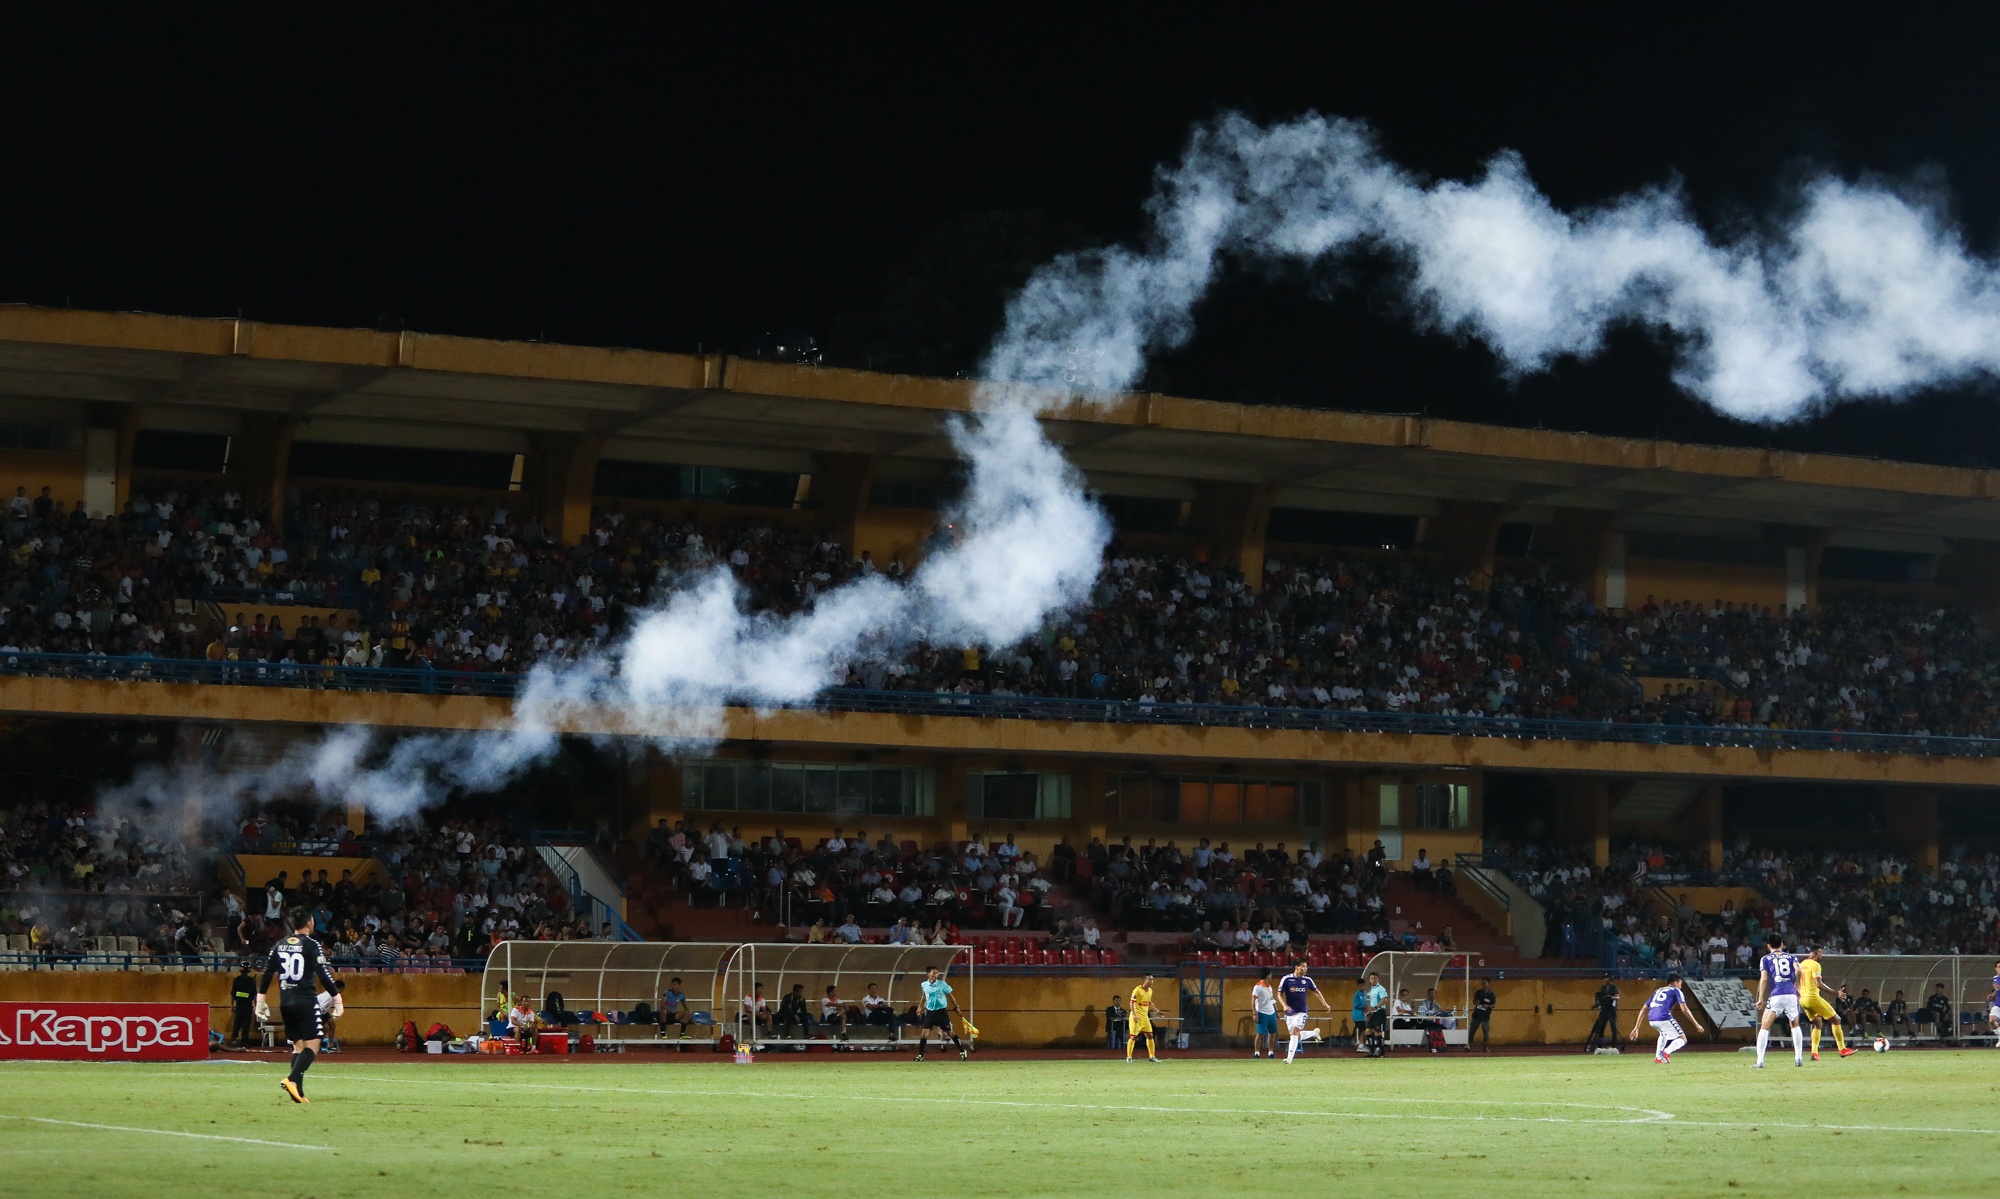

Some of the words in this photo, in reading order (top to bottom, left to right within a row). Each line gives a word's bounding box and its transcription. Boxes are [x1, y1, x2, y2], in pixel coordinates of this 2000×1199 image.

[277, 951, 305, 981] 30
[1772, 958, 1791, 976] 18
[1652, 988, 1671, 1002] 16
[17, 1010, 194, 1052] Kappa
